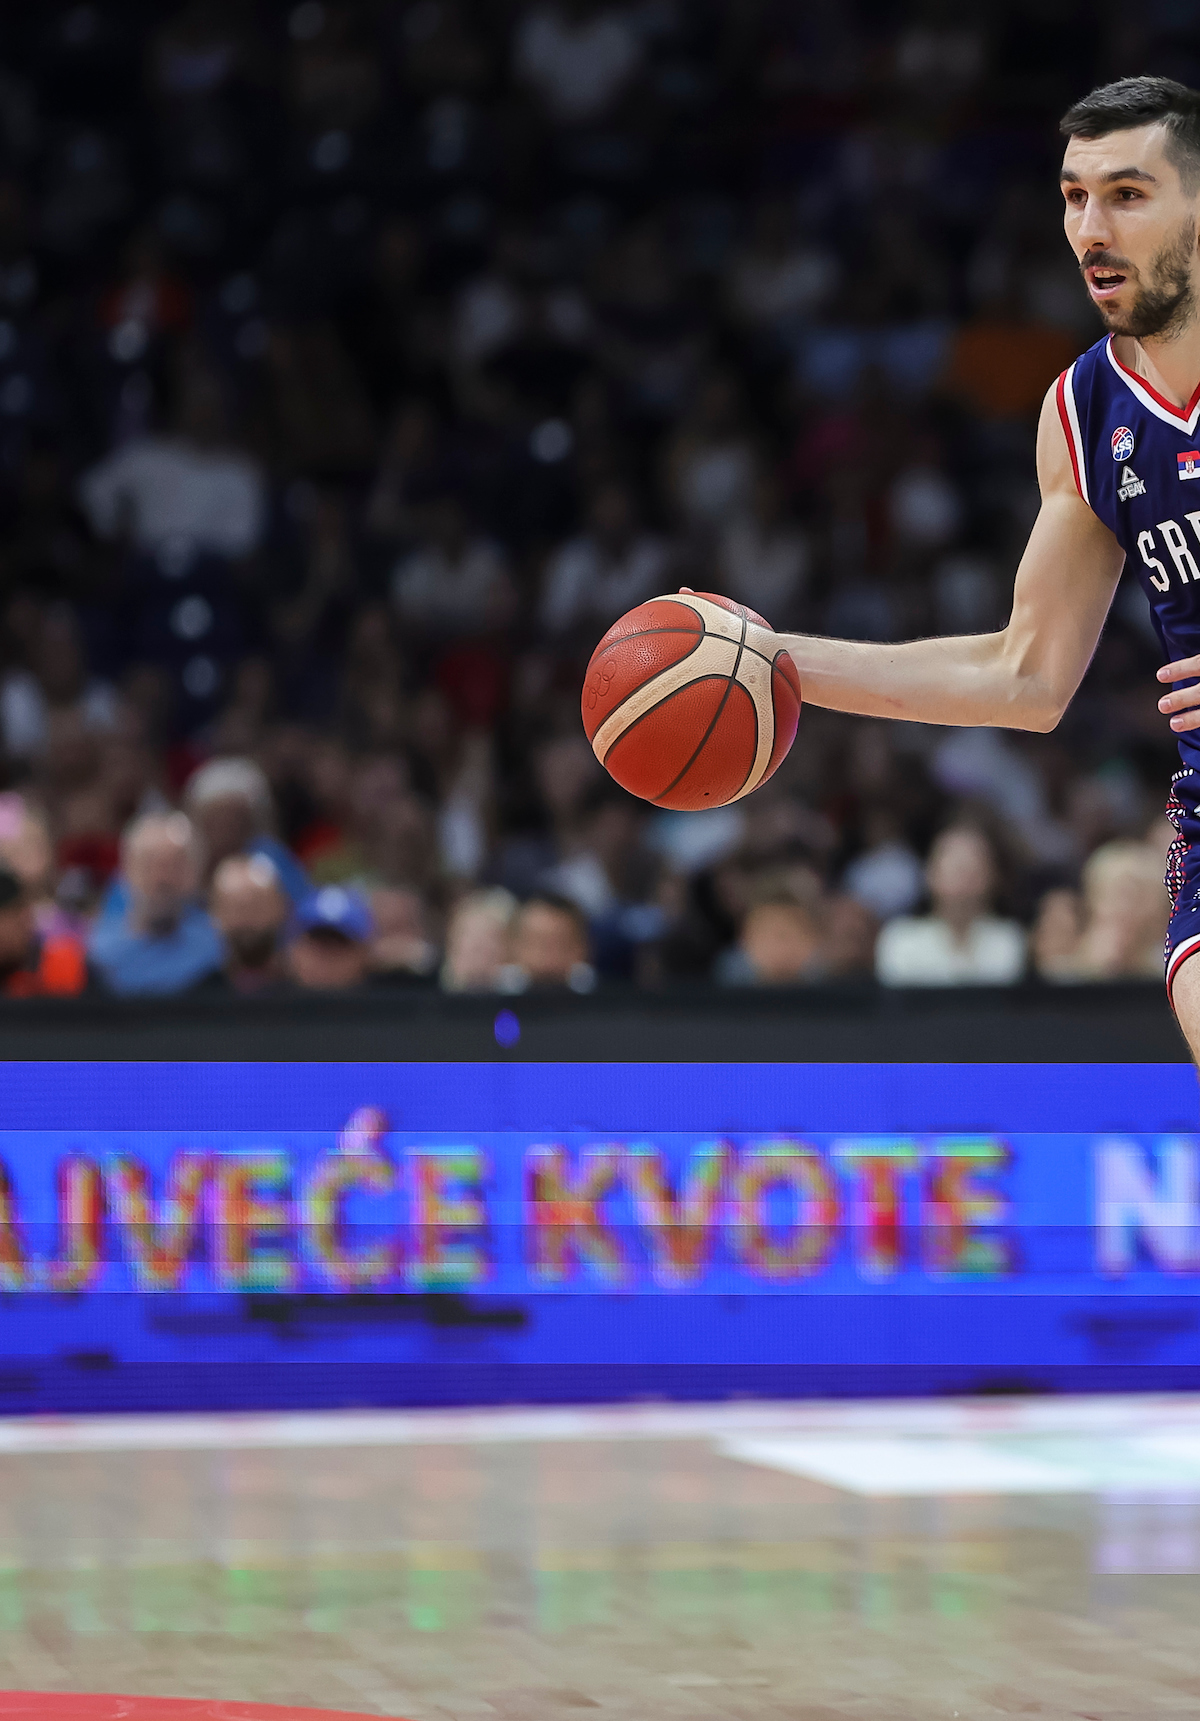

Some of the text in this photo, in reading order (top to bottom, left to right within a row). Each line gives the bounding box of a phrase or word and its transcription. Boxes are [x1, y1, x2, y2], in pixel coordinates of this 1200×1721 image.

[1113, 438, 1133, 455] KSS
[1117, 480, 1147, 502] PEAK
[524, 1138, 1012, 1288] KVOTE
